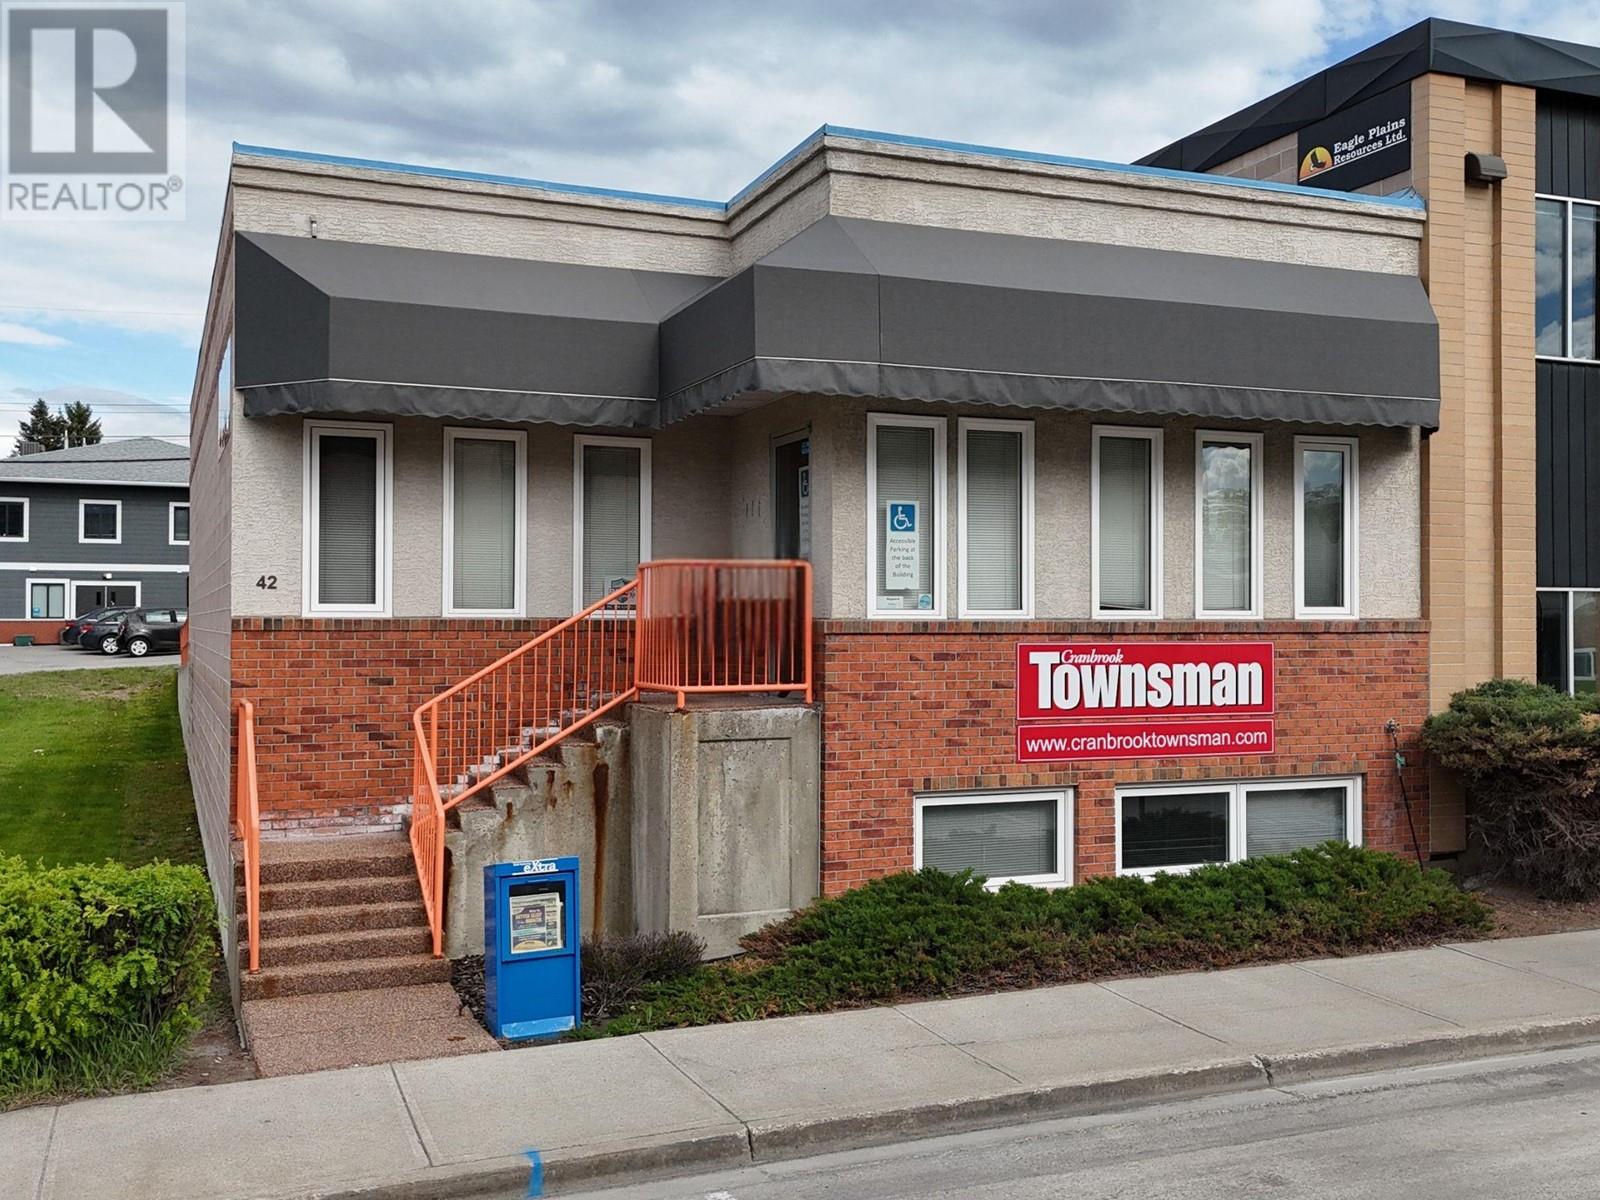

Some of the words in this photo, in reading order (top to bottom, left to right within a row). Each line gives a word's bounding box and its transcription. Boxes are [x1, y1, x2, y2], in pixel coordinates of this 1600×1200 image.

[1333, 134, 1365, 154] Eagle
[1368, 117, 1406, 140] Plains
[1333, 140, 1383, 166] Resources
[1385, 129, 1406, 145] Ltd.
[256, 575, 277, 590] 42
[1061, 649, 1123, 664] Cranbrook
[1029, 652, 1263, 709] Townsman
[1026, 730, 1267, 753] www.cranbrooktownsman.com
[523, 861, 556, 873] eXtra
